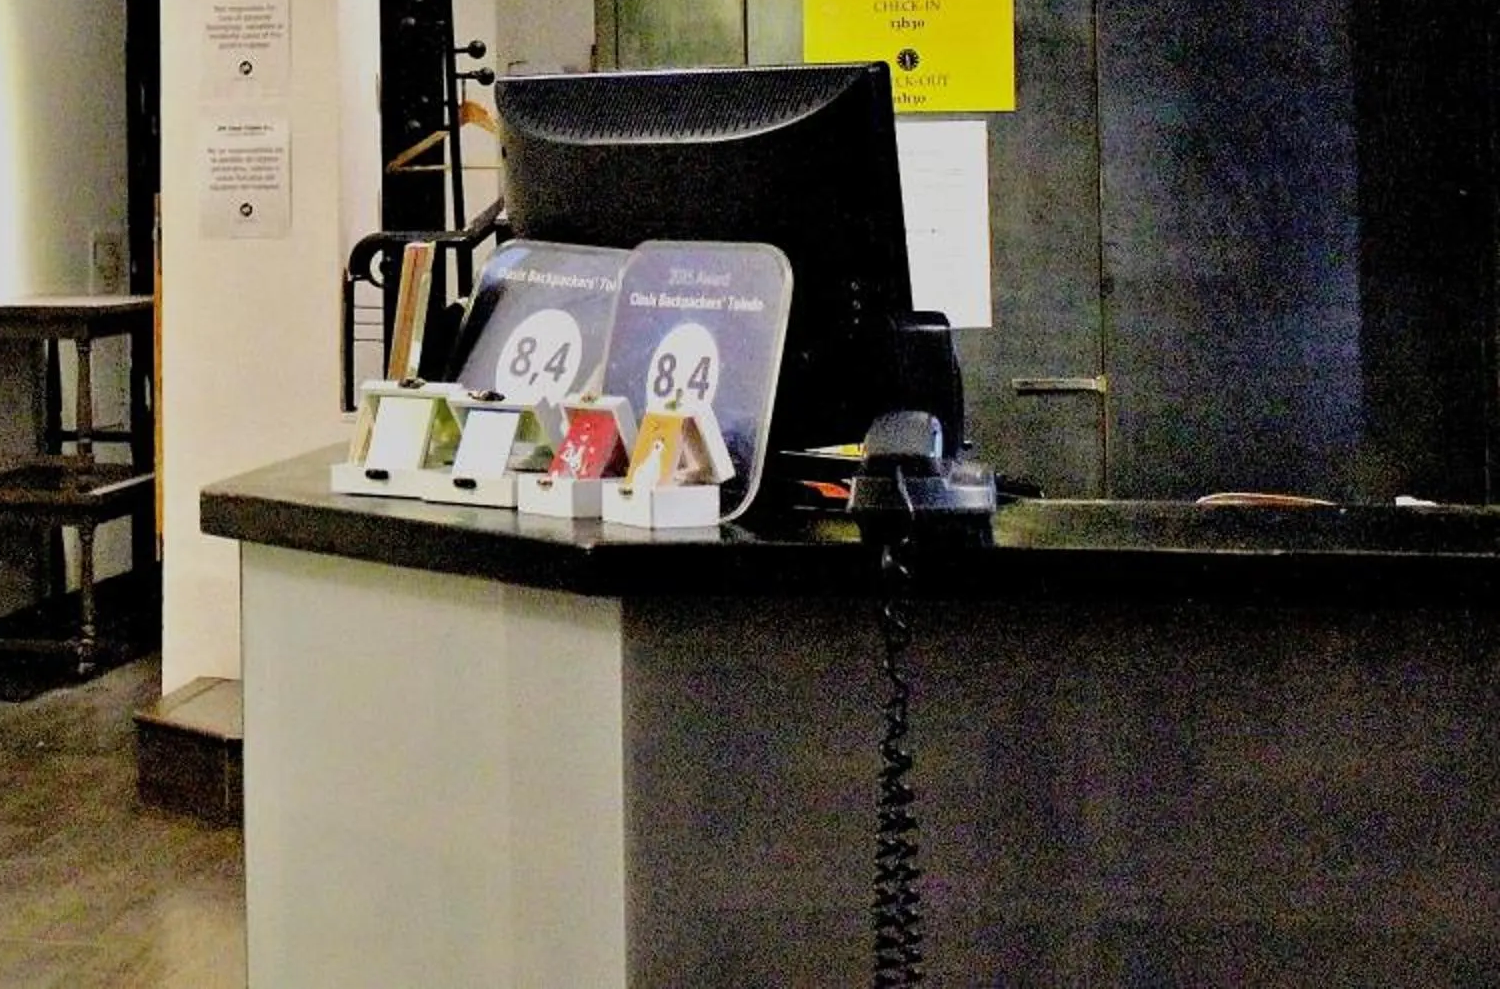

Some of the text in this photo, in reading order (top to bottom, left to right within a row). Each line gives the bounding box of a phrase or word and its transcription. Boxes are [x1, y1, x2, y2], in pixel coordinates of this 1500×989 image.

[895, 74, 948, 88] CK-OUT
[508, 335, 572, 386] 8,4
[653, 352, 712, 400] 8,4
